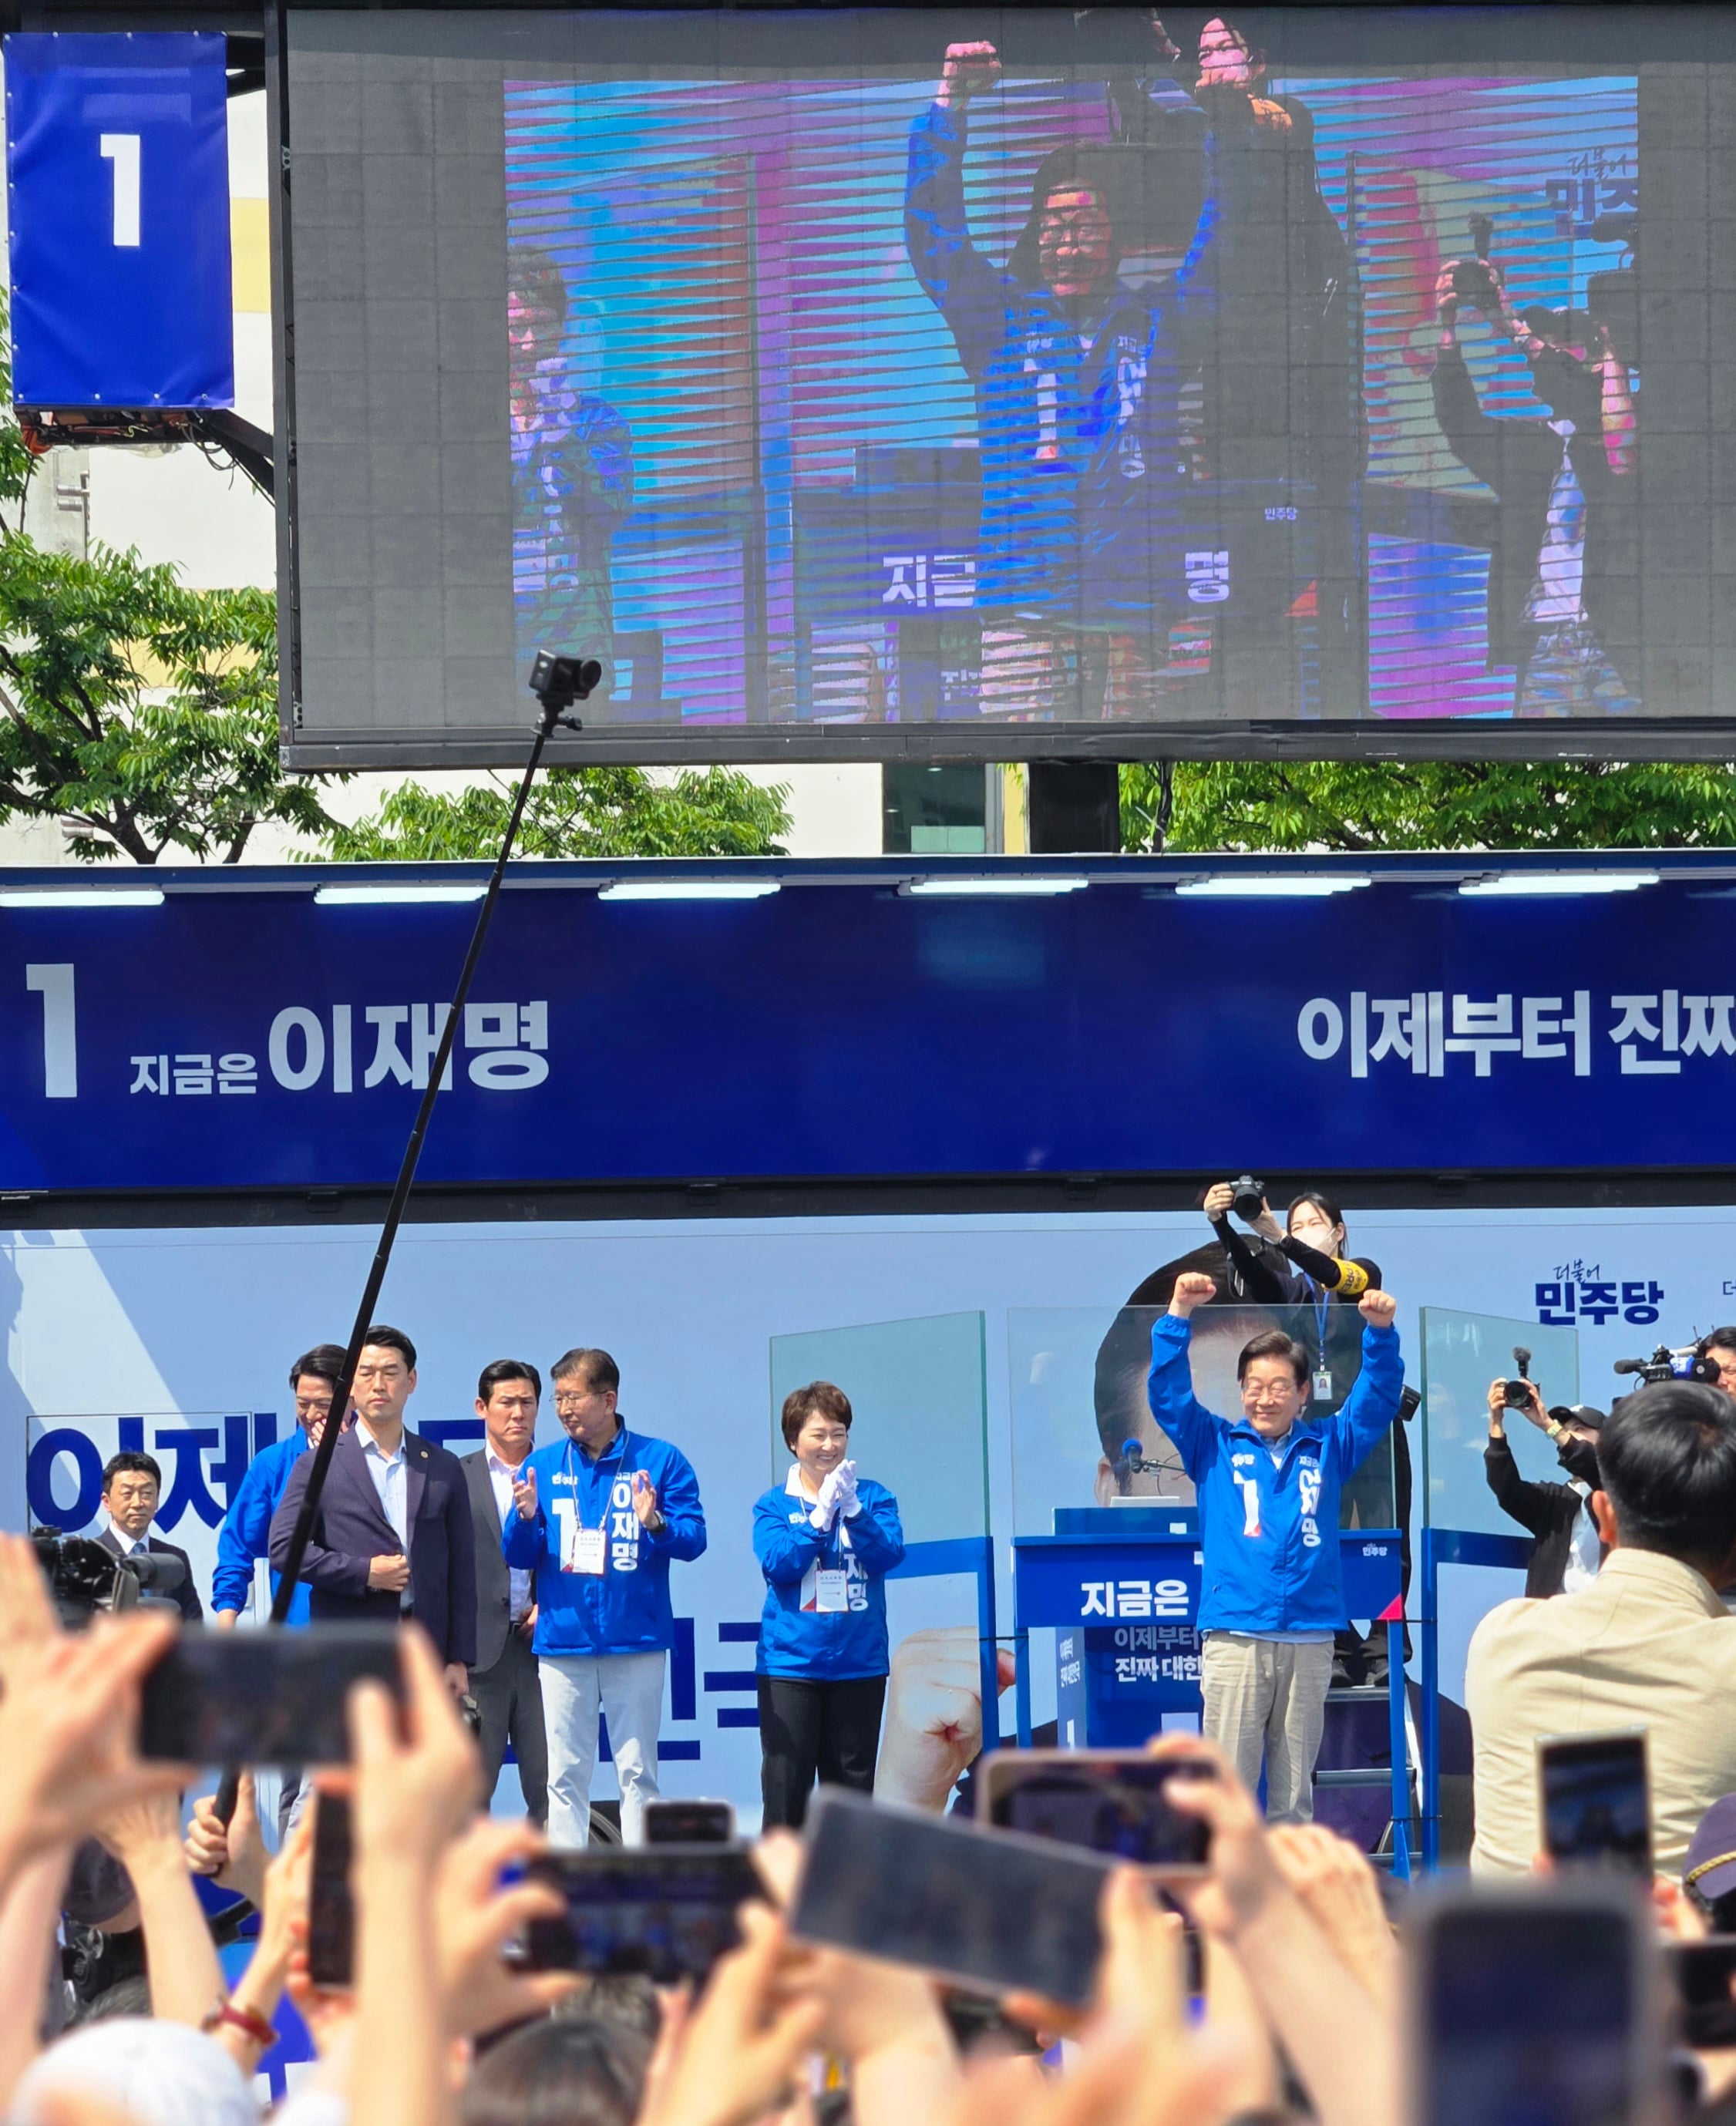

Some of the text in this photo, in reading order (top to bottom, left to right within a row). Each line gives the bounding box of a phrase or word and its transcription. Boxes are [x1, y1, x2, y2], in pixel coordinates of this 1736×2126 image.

[100, 134, 140, 246] 1
[1265, 506, 1298, 521] 민주당
[26, 964, 76, 1098] 1
[130, 1001, 550, 1095] 지금은 이재명
[1297, 990, 1591, 1078] 이제부터
[1553, 1258, 1600, 1283] 더불어
[1535, 1280, 1664, 1325] 민주당
[1233, 1470, 1261, 1537] 1
[552, 1498, 579, 1573] 1
[1362, 1546, 1388, 1557] 민주당
[1081, 1579, 1189, 1617] 지금은
[1114, 1626, 1199, 1651] 이제부터
[1115, 1656, 1159, 1682] 진짜
